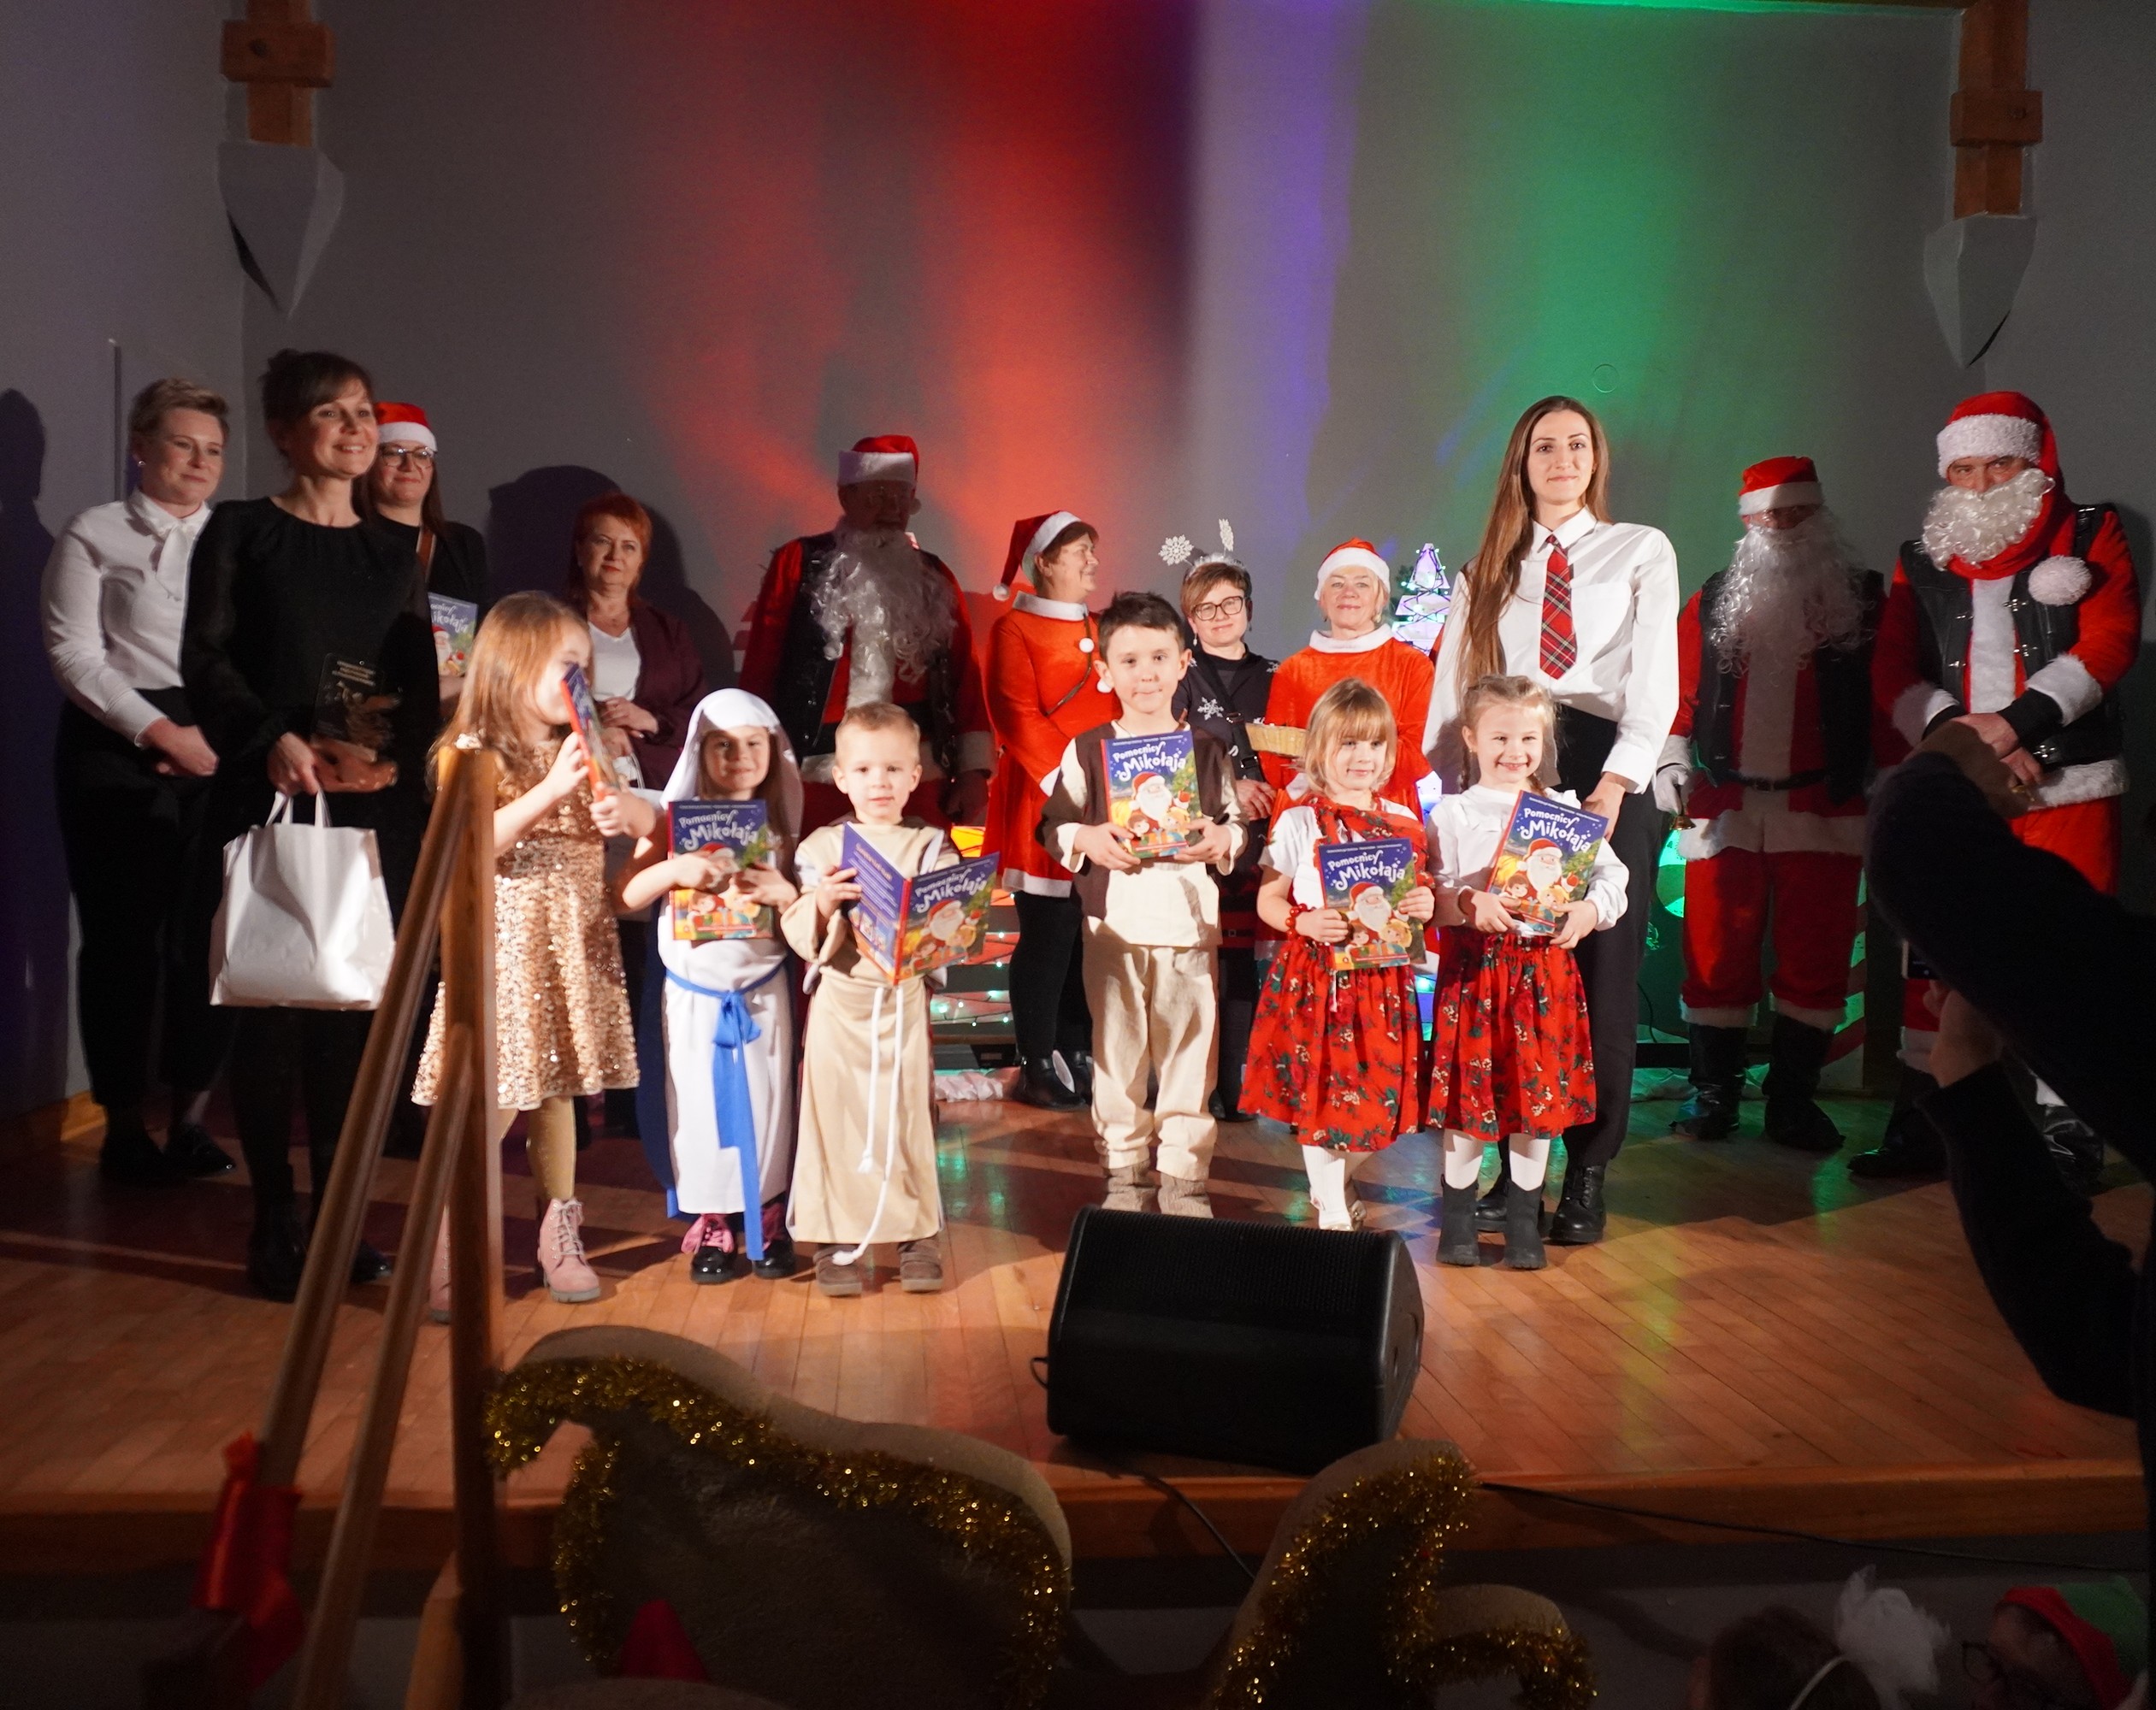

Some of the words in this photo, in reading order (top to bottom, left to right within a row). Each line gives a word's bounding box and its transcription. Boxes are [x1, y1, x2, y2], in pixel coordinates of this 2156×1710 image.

[431, 610, 469, 634] ikołaja
[1113, 740, 1166, 763] Pomocnicy
[1119, 752, 1187, 781] Mikołaja
[678, 809, 739, 828] Pomocnicy
[1523, 807, 1580, 828] Pomocnicy
[683, 821, 759, 852] Mikołaja
[1520, 819, 1592, 853] Mikołaja
[1327, 849, 1384, 871] Pomocnicy
[914, 868, 972, 897] Pomocnicy
[1334, 859, 1406, 891] Mikołaja
[916, 877, 988, 913] Mikołaja
